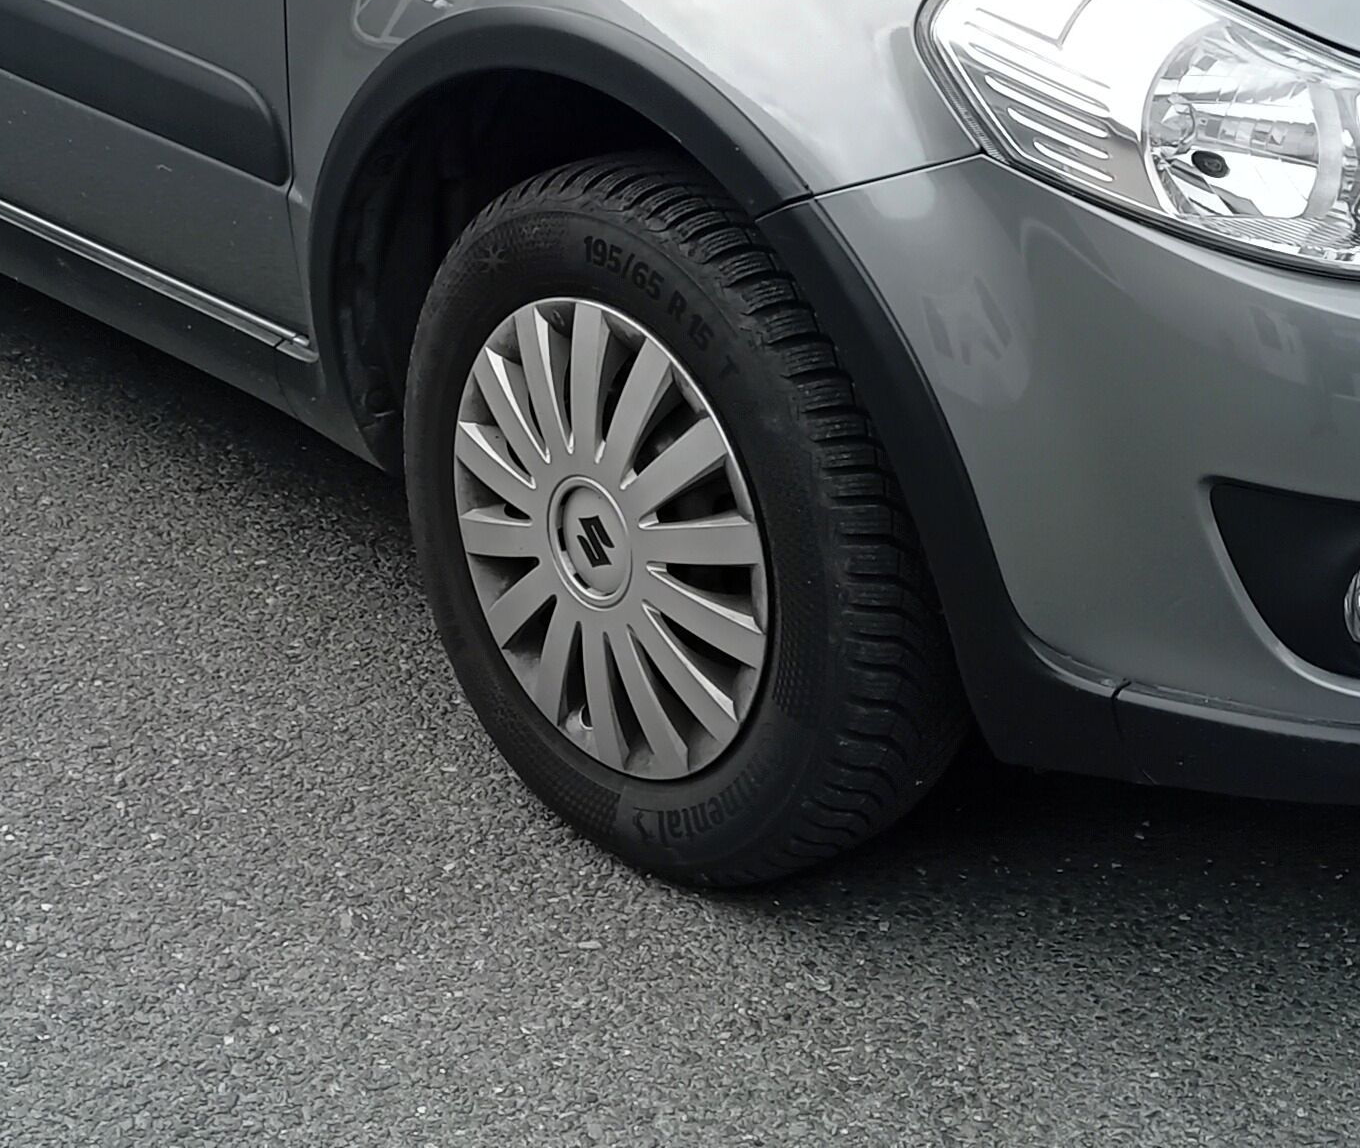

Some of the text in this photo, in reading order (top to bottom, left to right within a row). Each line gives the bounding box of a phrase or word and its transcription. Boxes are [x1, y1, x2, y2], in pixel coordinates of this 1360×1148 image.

[583, 235, 665, 300] 195/65
[667, 290, 688, 323] R
[688, 313, 715, 352] 15
